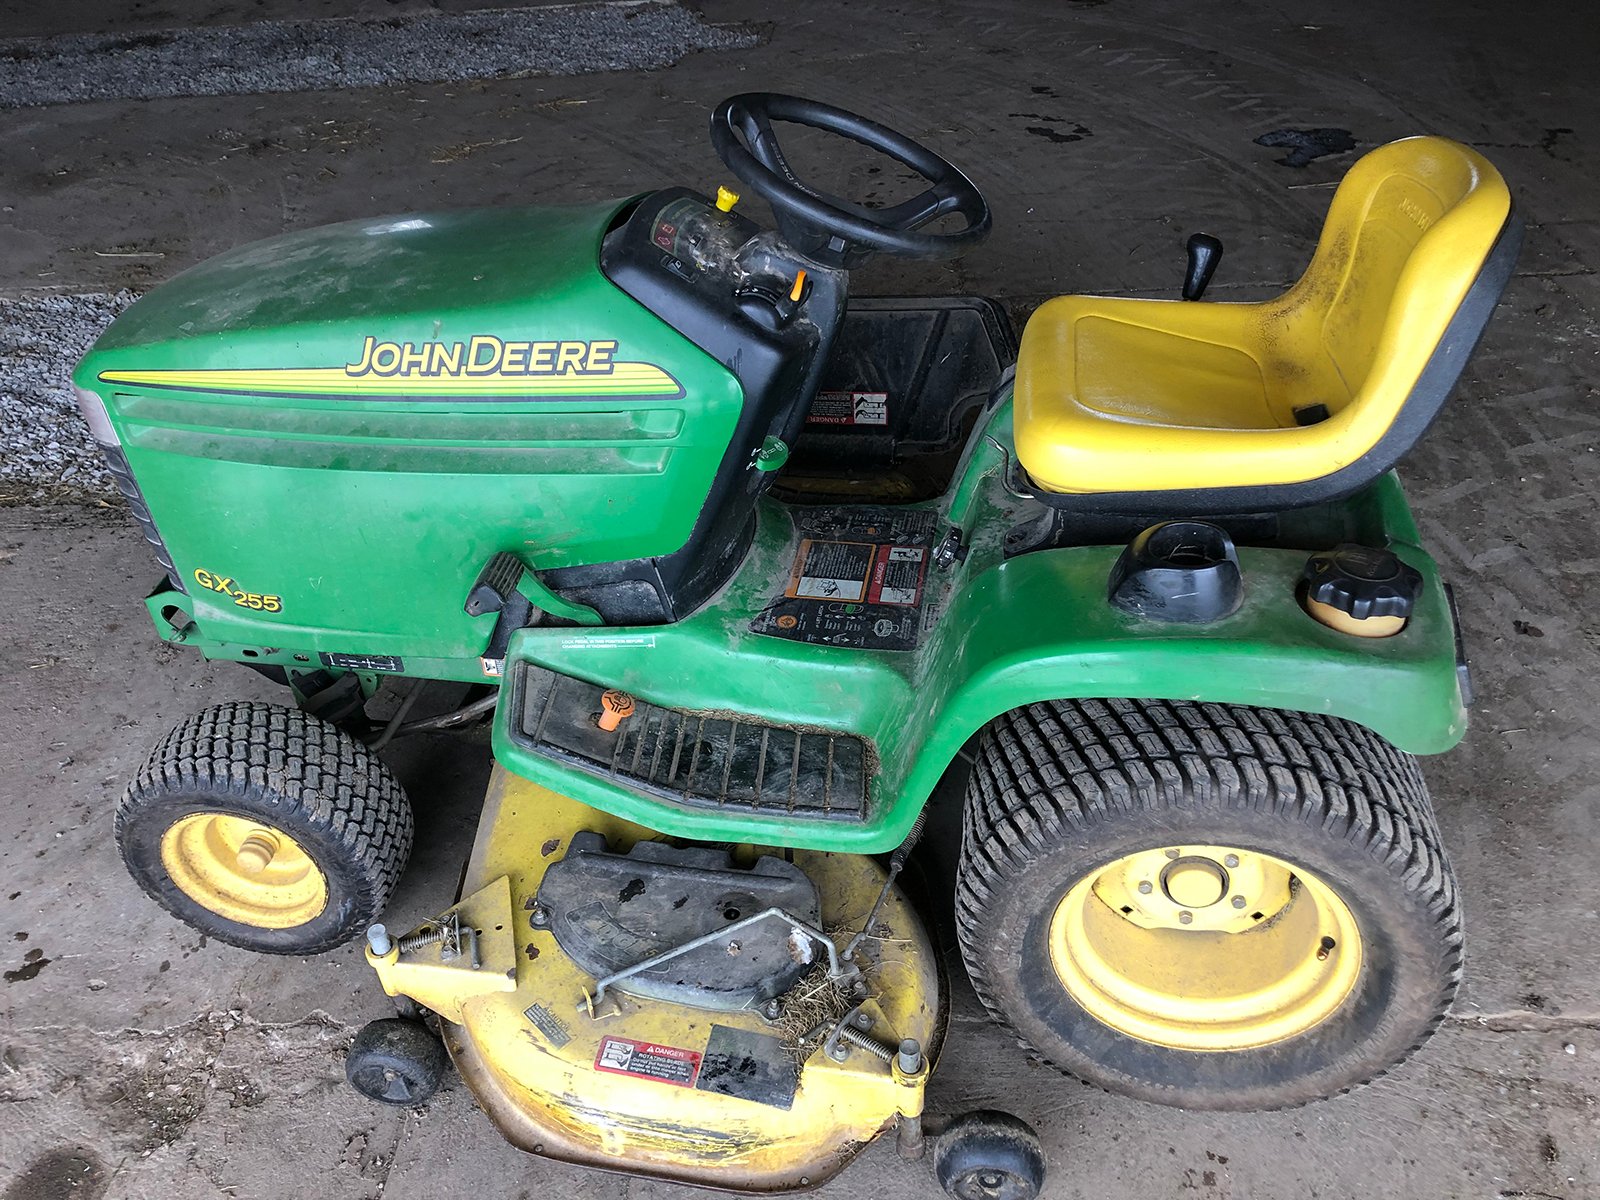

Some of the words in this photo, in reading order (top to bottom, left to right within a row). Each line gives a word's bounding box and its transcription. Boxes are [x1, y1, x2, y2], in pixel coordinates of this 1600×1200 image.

[345, 336, 464, 377] JOHN
[465, 335, 618, 376] DEERE
[875, 562, 884, 580] DANGER
[194, 568, 234, 596] GX
[234, 590, 282, 613] 255
[638, 1053, 666, 1062] ROTATING
[655, 1047, 684, 1058] DANGER
